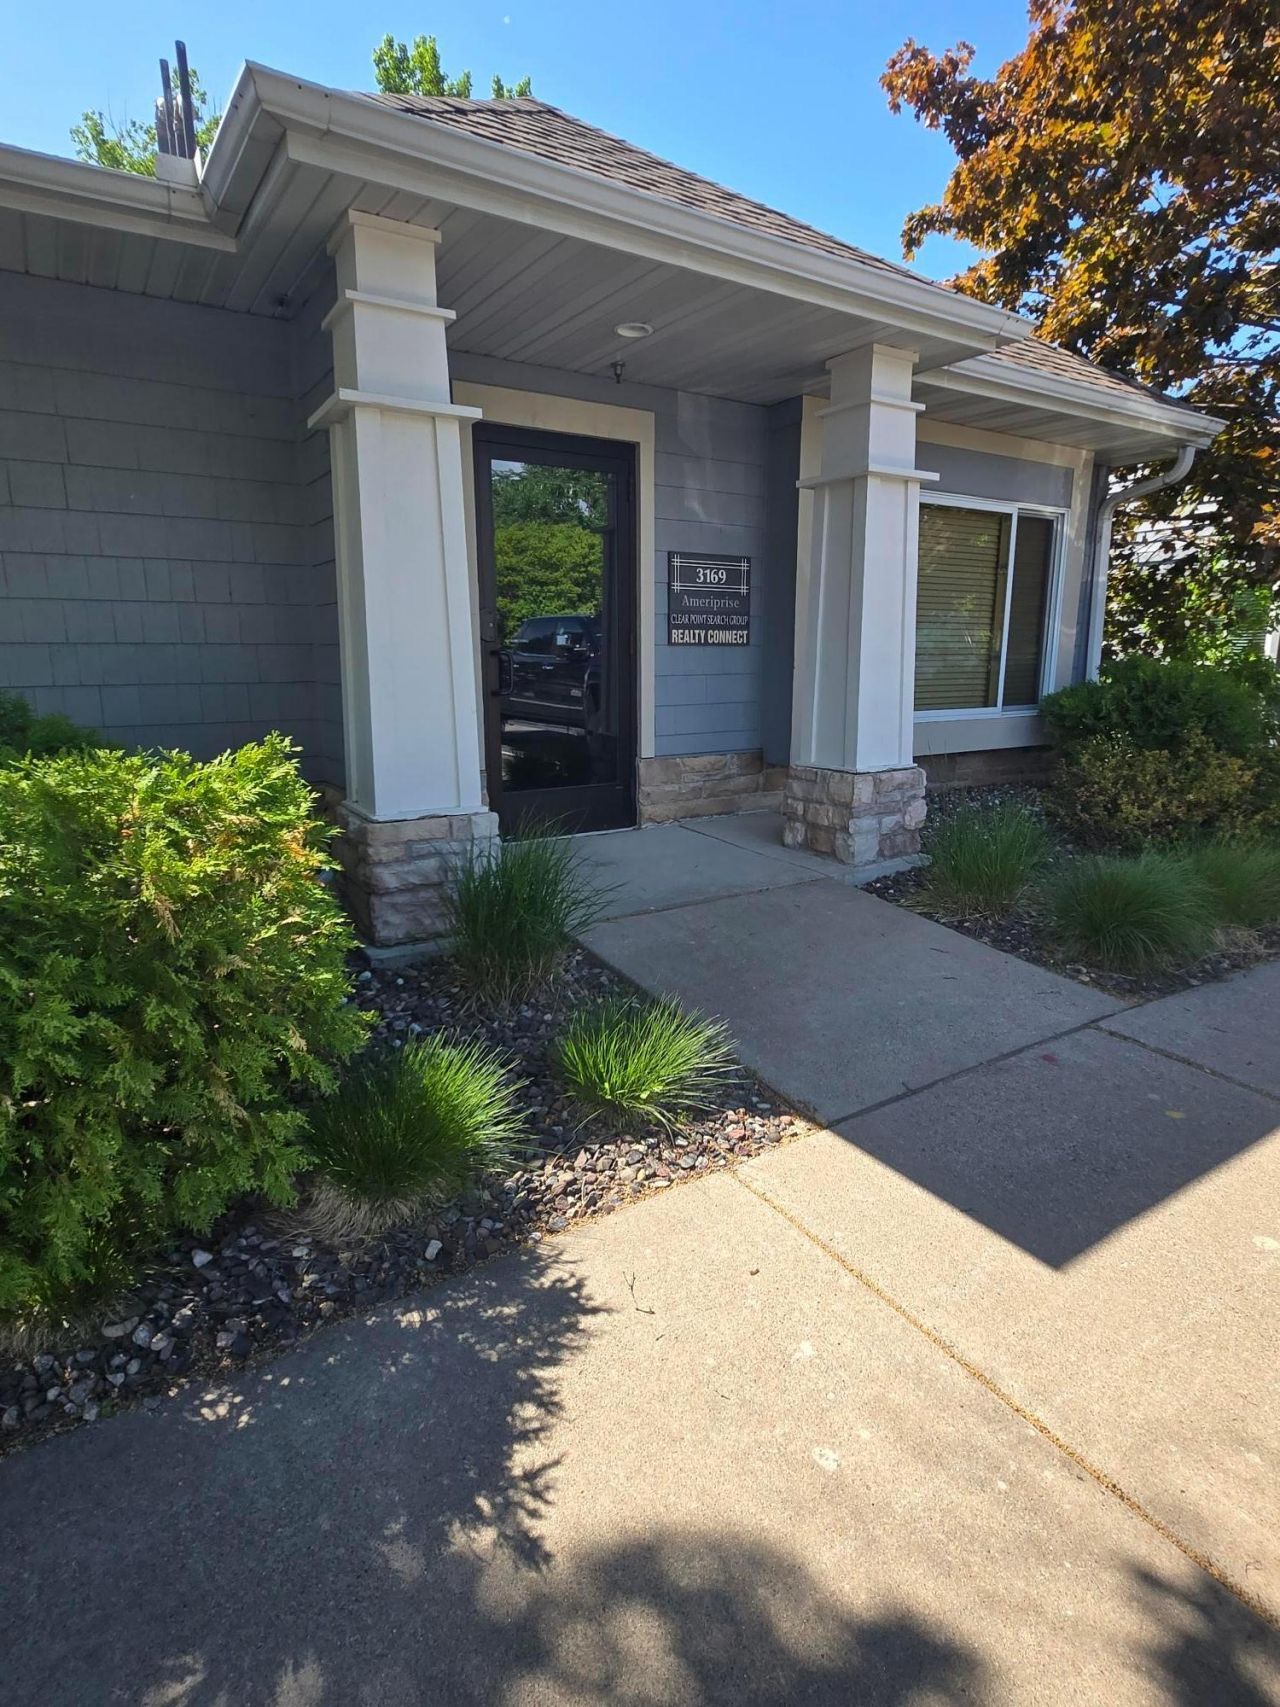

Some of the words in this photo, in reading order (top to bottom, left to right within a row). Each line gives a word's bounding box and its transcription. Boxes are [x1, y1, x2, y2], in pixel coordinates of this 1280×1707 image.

[696, 568, 727, 584] 3169
[682, 595, 740, 611] Ameriprise
[671, 614, 689, 624] CLEAR
[690, 614, 706, 624] POINT
[707, 615, 729, 625] SEARCH
[730, 615, 748, 625] GROUP
[672, 630, 705, 643] REALTY
[707, 630, 748, 643] CONNECT
